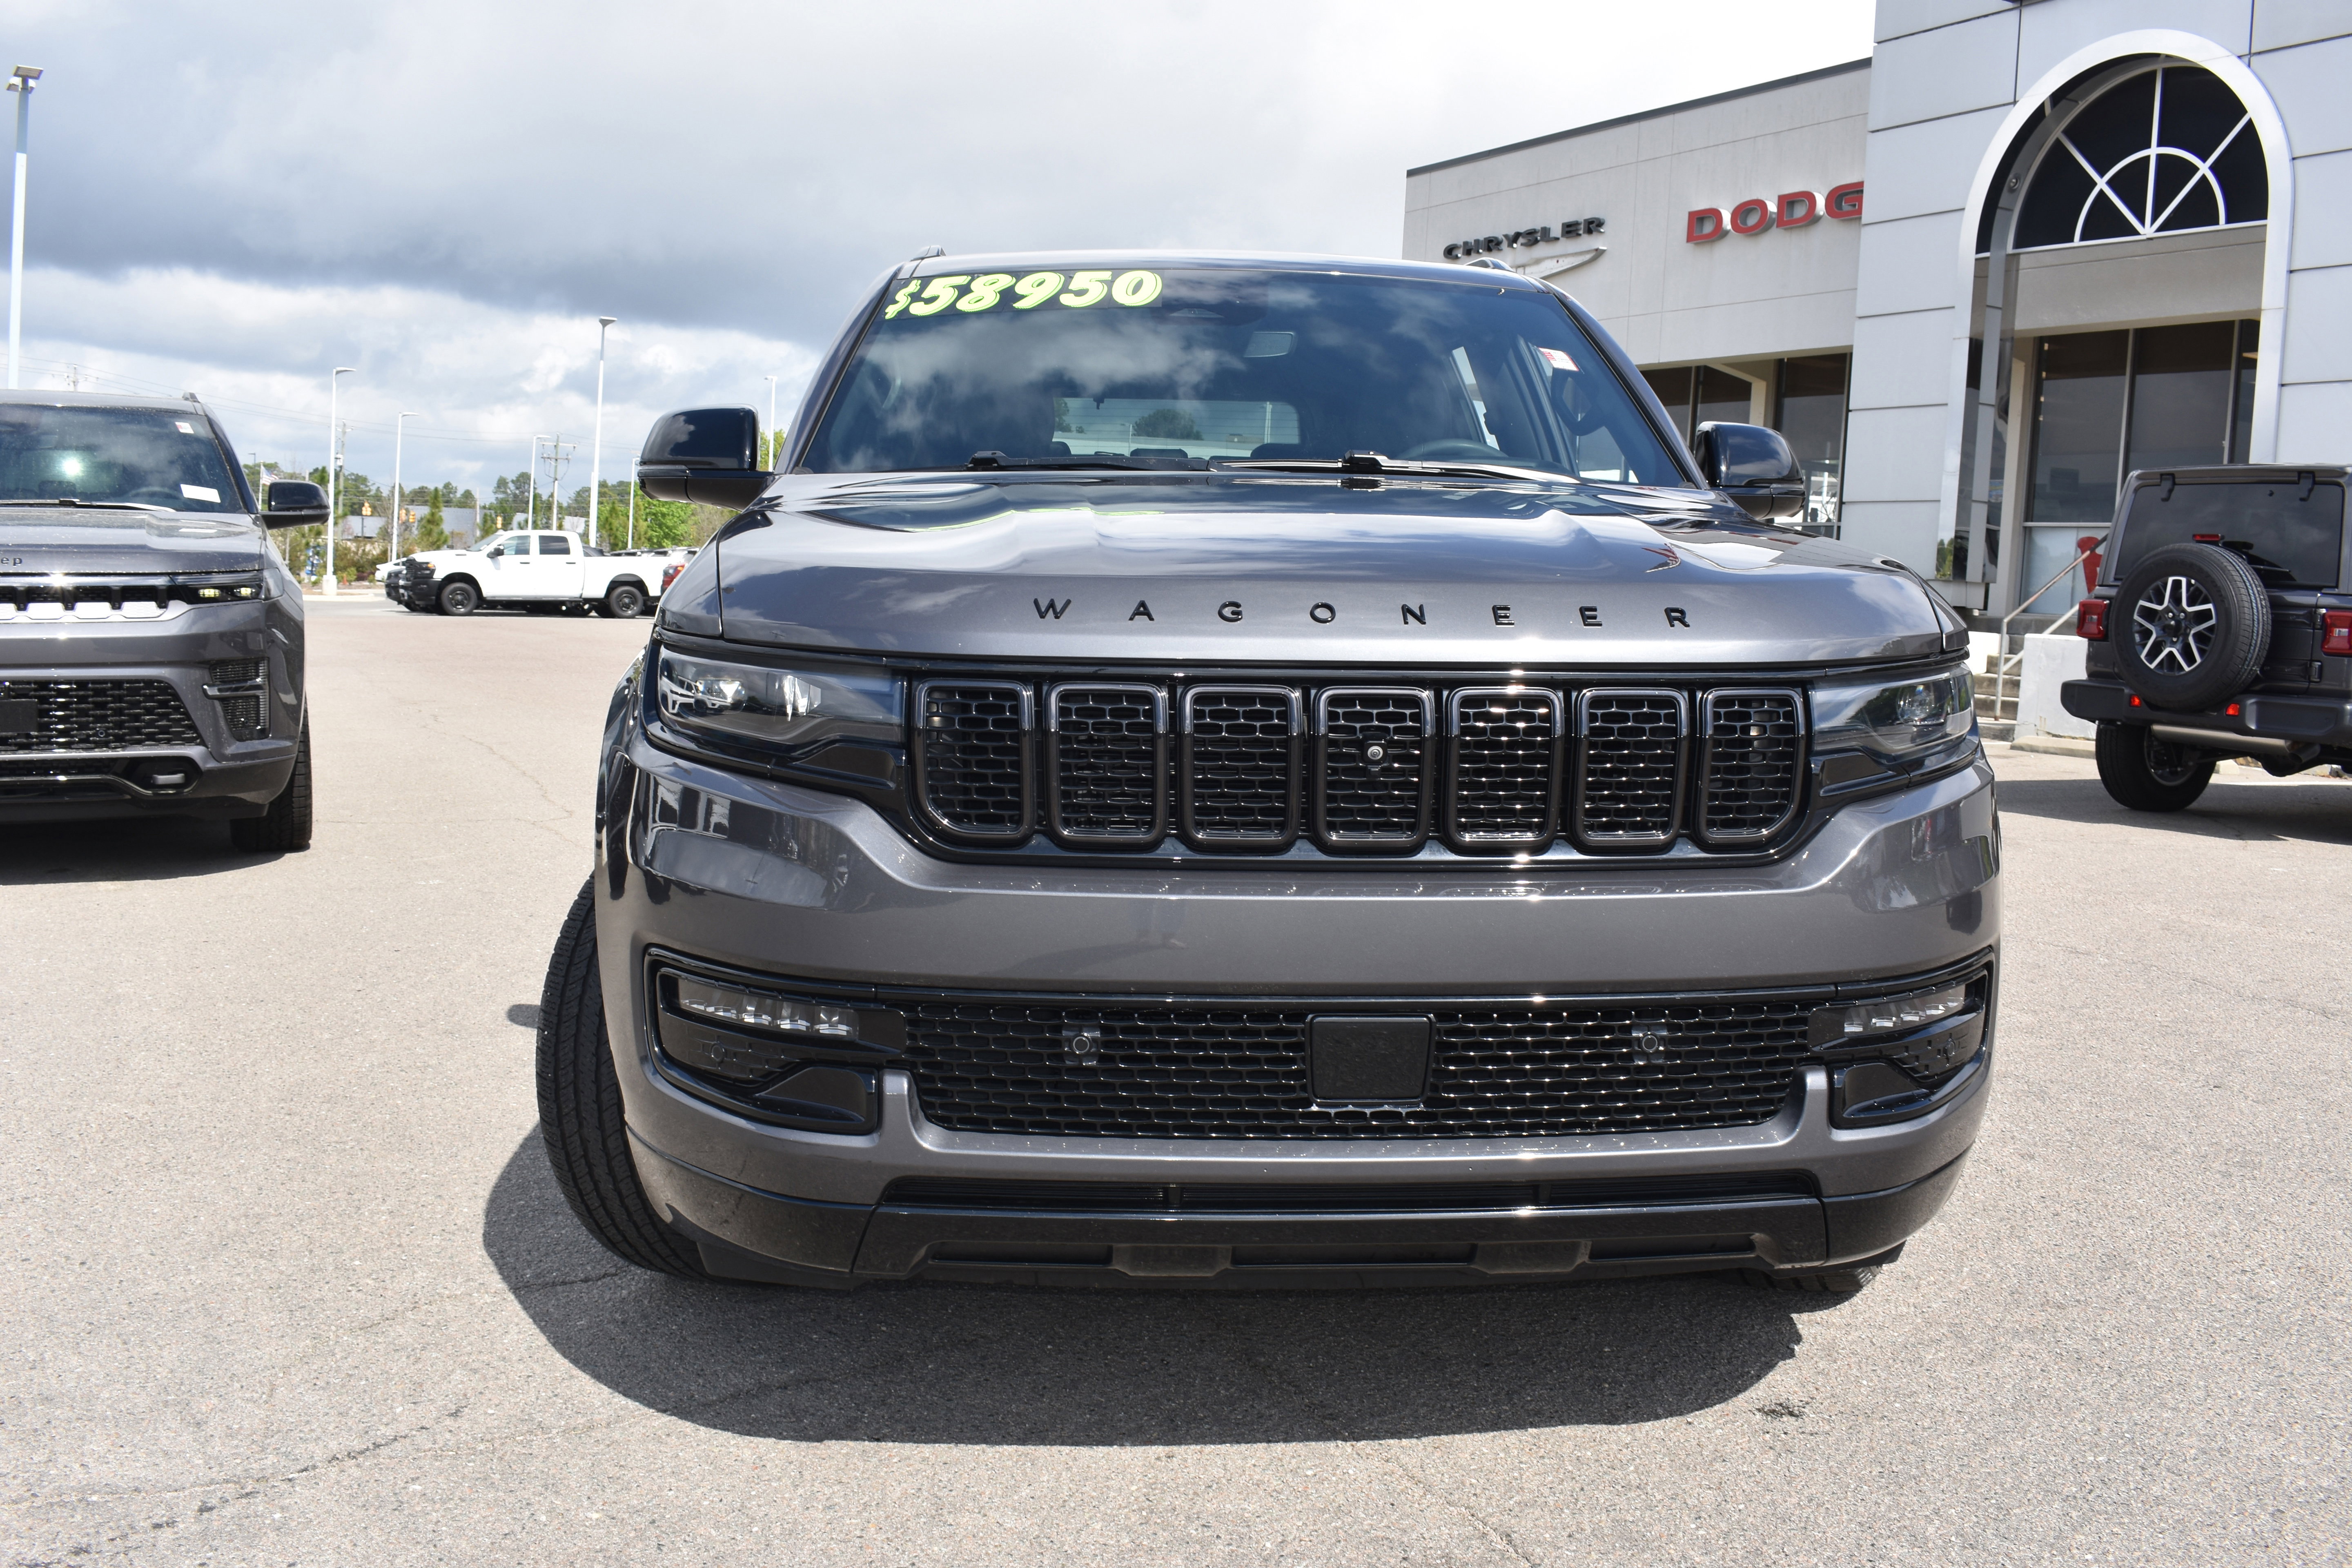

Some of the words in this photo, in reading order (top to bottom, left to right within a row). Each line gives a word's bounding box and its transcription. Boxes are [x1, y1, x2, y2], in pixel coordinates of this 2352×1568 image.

[1686, 180, 1864, 244] DODG
[1443, 217, 1606, 260] CHRYSLER
[884, 270, 1163, 320] $58950
[1033, 598, 1690, 628] WAGONEER
